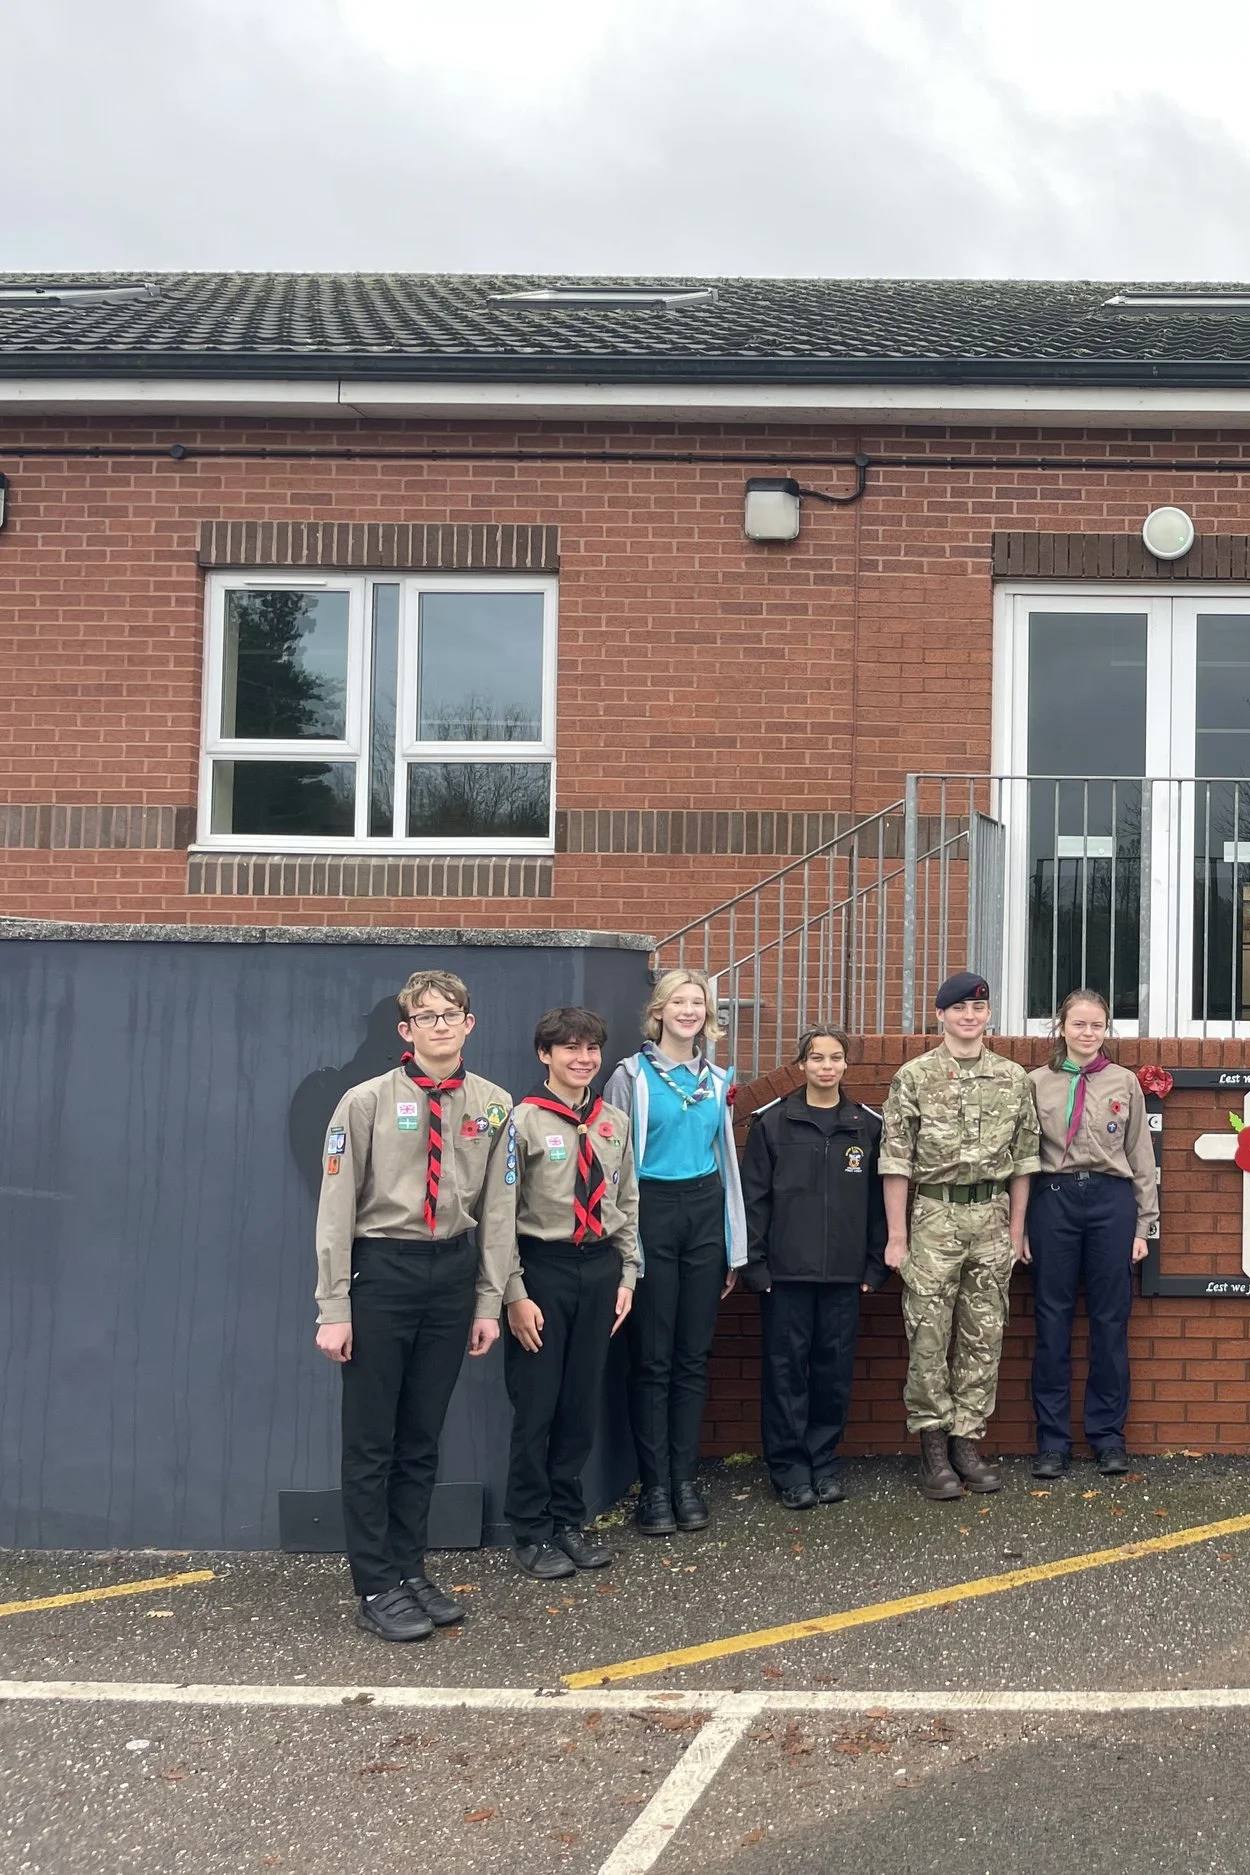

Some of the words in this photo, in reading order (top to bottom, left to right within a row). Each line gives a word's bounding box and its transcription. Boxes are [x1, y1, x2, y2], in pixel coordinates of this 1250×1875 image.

[1219, 1073, 1240, 1083] Lest
[1206, 1282, 1228, 1292] Lest
[1231, 1284, 1246, 1292] we
